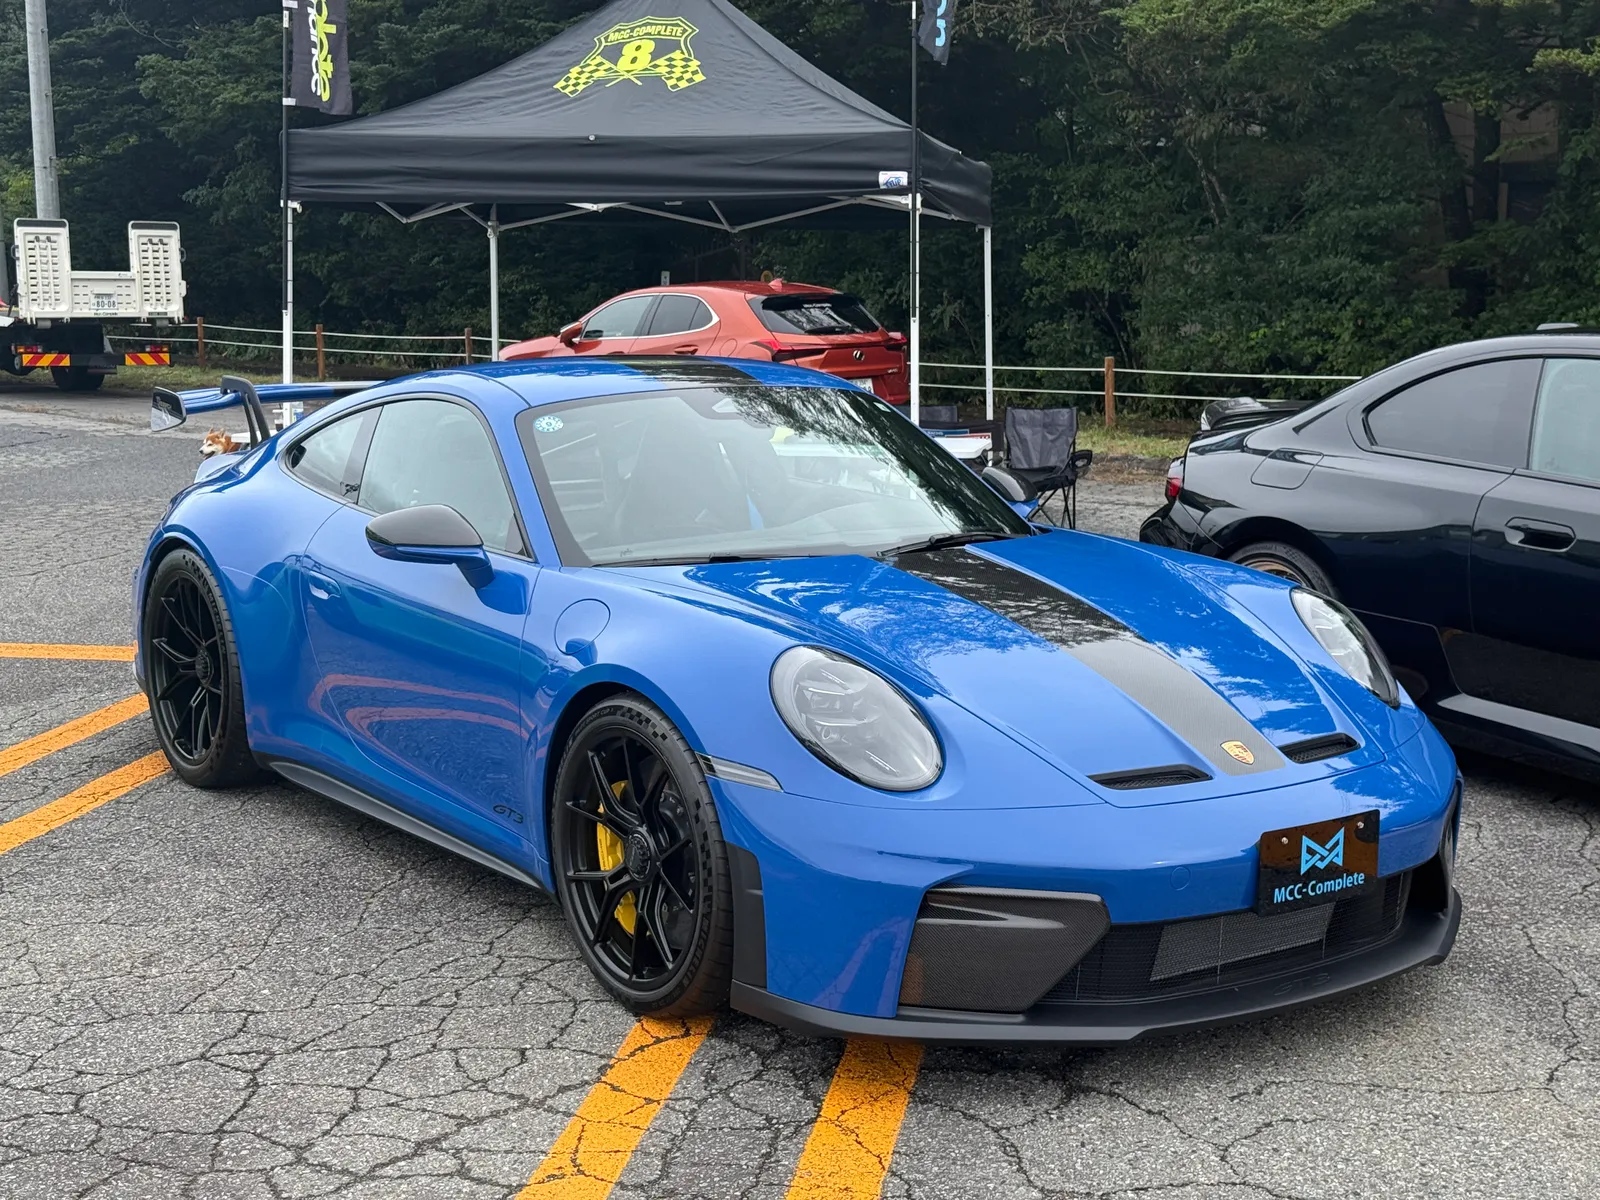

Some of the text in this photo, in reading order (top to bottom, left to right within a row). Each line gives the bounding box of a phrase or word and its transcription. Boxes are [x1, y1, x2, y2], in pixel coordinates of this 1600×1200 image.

[607, 25, 684, 42] MCC-COMPLETE
[616, 39, 655, 71] 8
[96, 300, 116, 308] 80-08
[493, 804, 524, 824] GT3
[1273, 872, 1365, 904] MCC-Complete
[682, 914, 711, 988] MICHELIN
